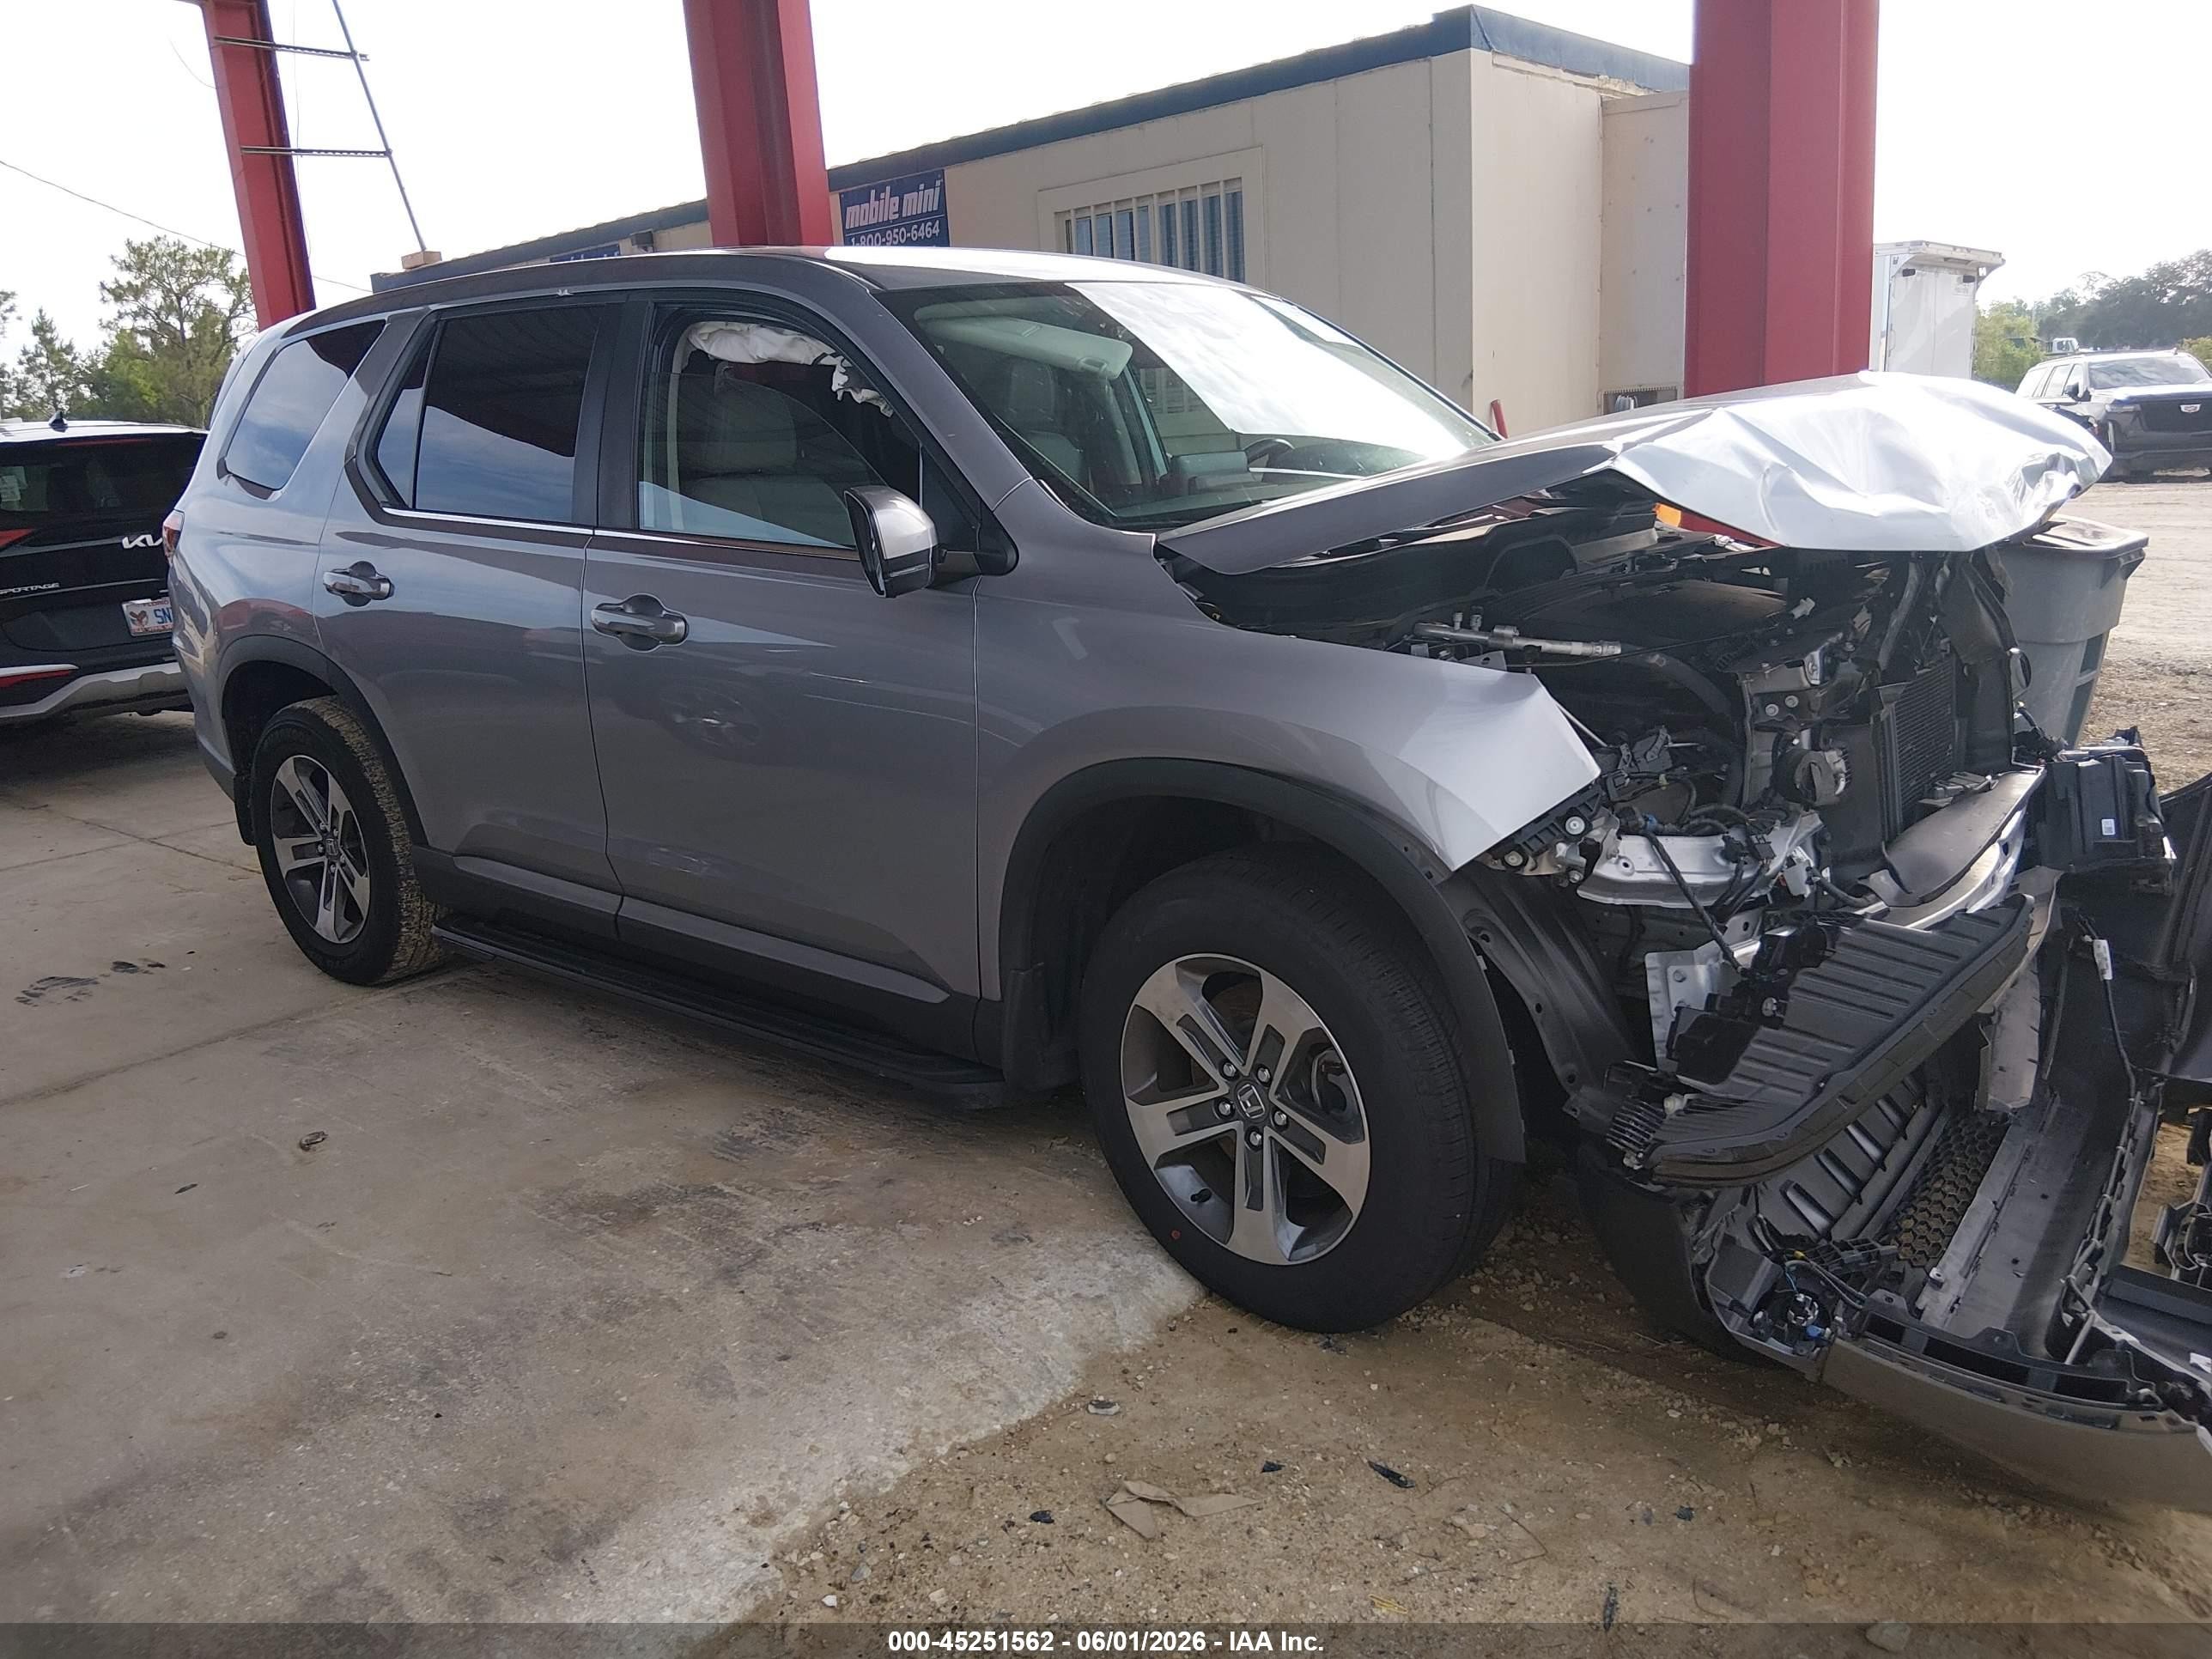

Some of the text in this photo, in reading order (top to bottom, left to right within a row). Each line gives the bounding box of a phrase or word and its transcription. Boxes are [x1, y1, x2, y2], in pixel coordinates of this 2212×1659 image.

[846, 179, 941, 229] mobile mini
[851, 219, 940, 247] 1-800-950-6464
[154, 606, 173, 624] SN
